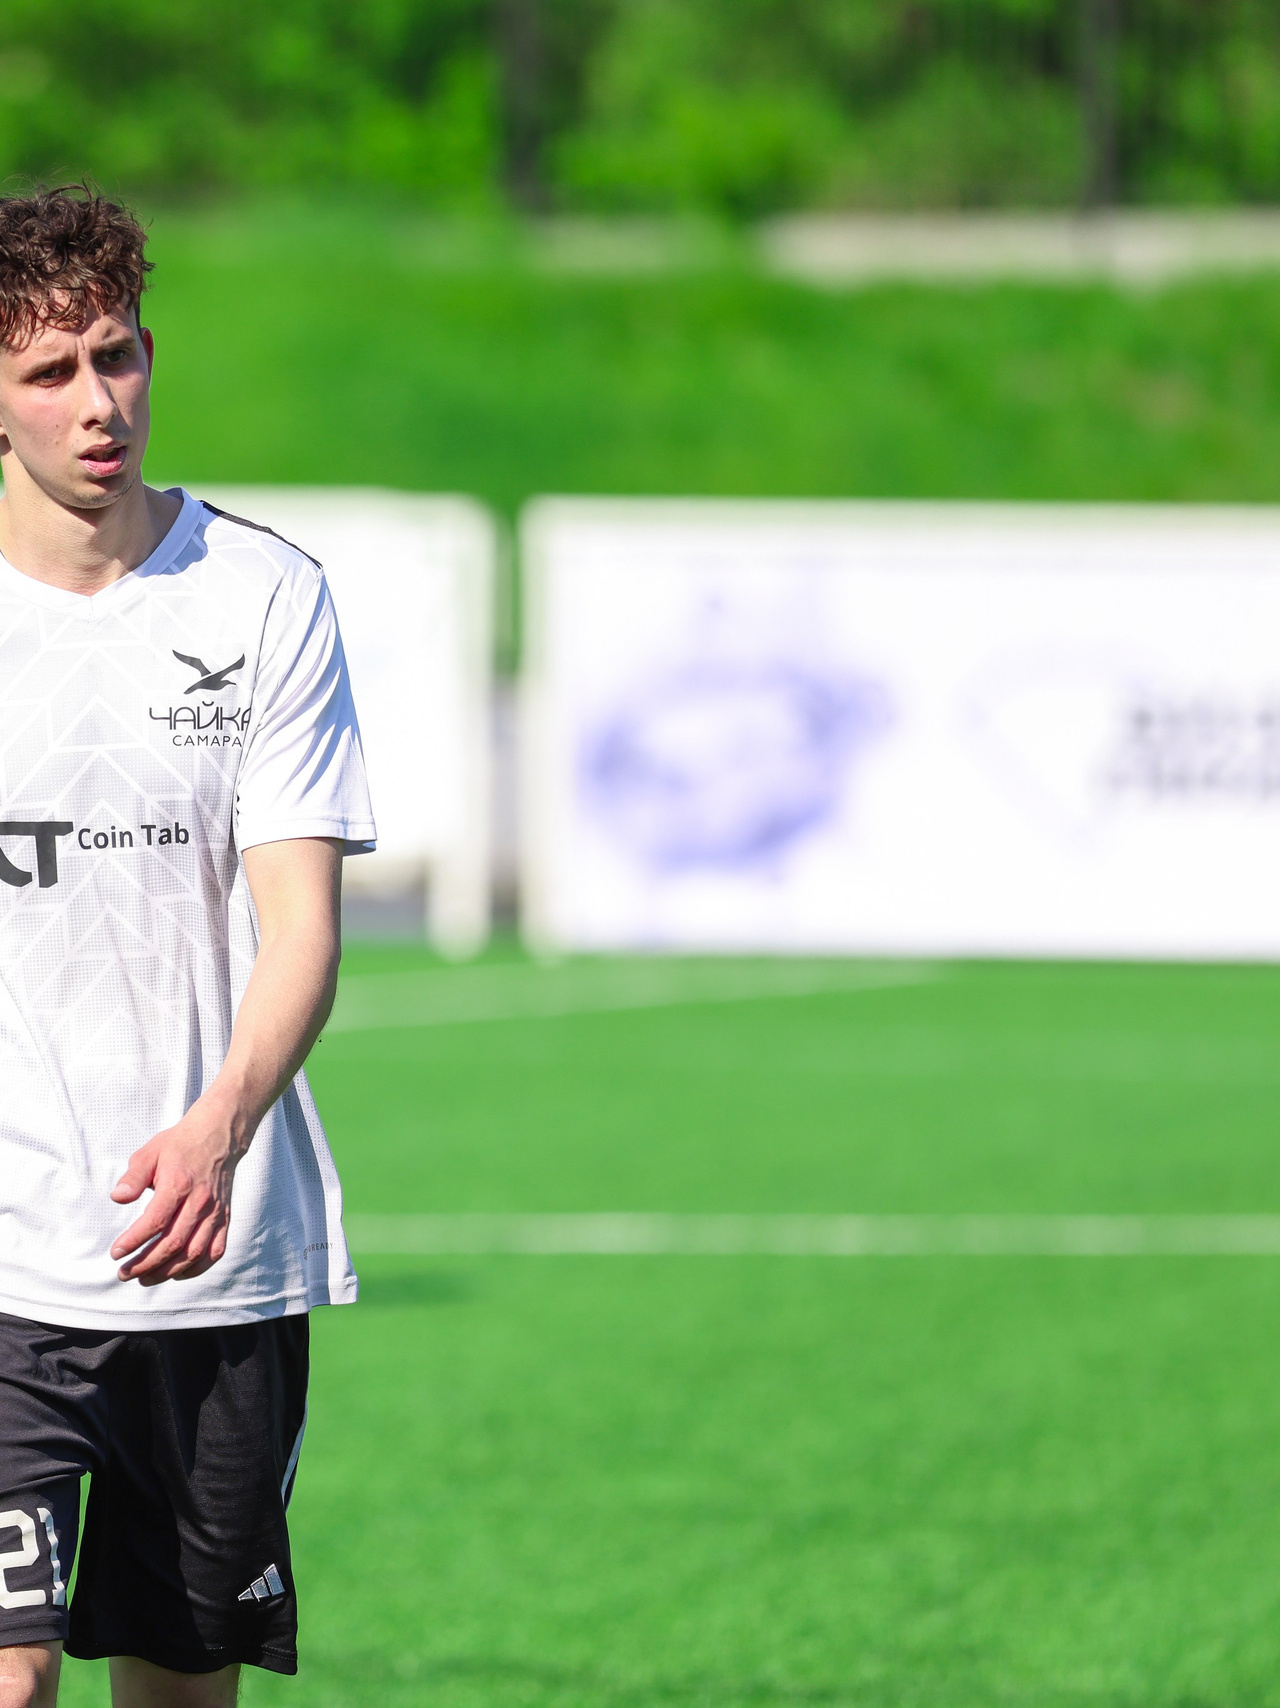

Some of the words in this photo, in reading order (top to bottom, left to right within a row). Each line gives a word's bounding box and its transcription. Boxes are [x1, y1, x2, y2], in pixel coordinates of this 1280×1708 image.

[172, 735, 242, 747] САМАРА
[78, 826, 134, 850] Coin
[140, 822, 190, 845] Tab
